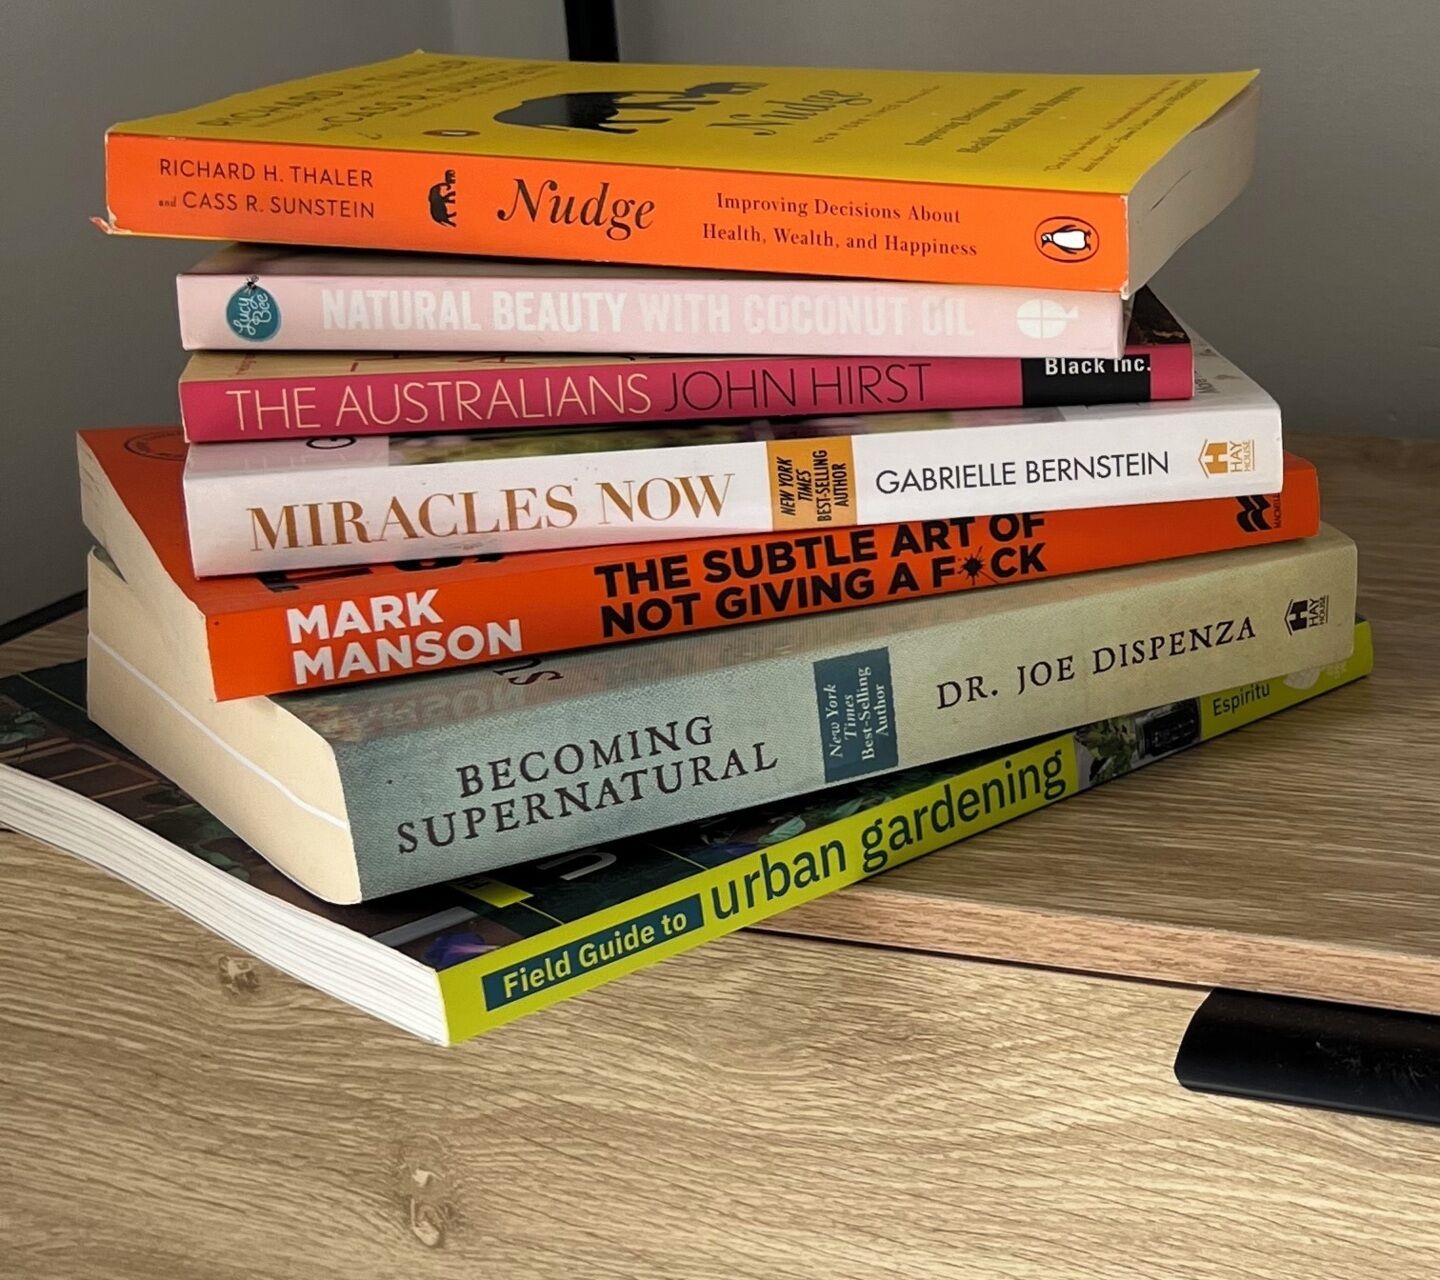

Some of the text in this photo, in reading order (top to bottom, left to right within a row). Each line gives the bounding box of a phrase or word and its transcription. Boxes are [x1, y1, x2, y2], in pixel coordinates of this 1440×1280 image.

[706, 88, 873, 136] Nudge
[160, 158, 373, 187] RICHARD H. THALER
[158, 191, 374, 218] and CASS R. SUNSTEIN
[497, 178, 655, 241] Nudge
[716, 193, 961, 223] Improving Decisions About
[703, 223, 977, 257] Health, Wealth, and Happiness
[233, 296, 258, 335] Lucy
[252, 293, 272, 325] Bee
[321, 289, 482, 331] NATURAL
[492, 290, 627, 333] BEAUTY
[638, 292, 731, 334] WITH
[743, 294, 909, 336] COCONUT
[1045, 358, 1151, 375] Black Inc.
[226, 363, 932, 431] THE AUSTRALIANS JOHN HIRST
[875, 451, 1169, 494] GABRIELLE BERNSTEIN
[1229, 440, 1243, 473] HAY
[1243, 440, 1252, 472] HOUSE
[776, 456, 796, 516] NEW YORK
[796, 469, 813, 502] TIMES
[812, 450, 832, 522] BEST-SELLING
[832, 463, 849, 507] AUTHOR
[246, 473, 736, 552] MIRACLES NOW
[594, 512, 1045, 598] THE SUBTLE ART OF
[287, 588, 443, 645] MARK
[601, 593, 701, 638] NOT
[716, 568, 874, 619] GIVING
[888, 562, 920, 595] A
[1309, 598, 1320, 627] HAY
[1318, 594, 1326, 625] HOUSE
[292, 619, 522, 685] MANSON
[937, 616, 1256, 709] DR. JOE DISPENZA
[823, 683, 843, 758] New York
[843, 694, 857, 740] Times
[856, 666, 875, 760] Best-Selling
[873, 684, 889, 736] Author
[1213, 682, 1270, 717] Espiritu
[456, 715, 714, 799] BECOMING
[397, 742, 779, 855] SUPERNATURAL
[711, 748, 1067, 920] urban gardening
[503, 911, 687, 999] Field Guide to
